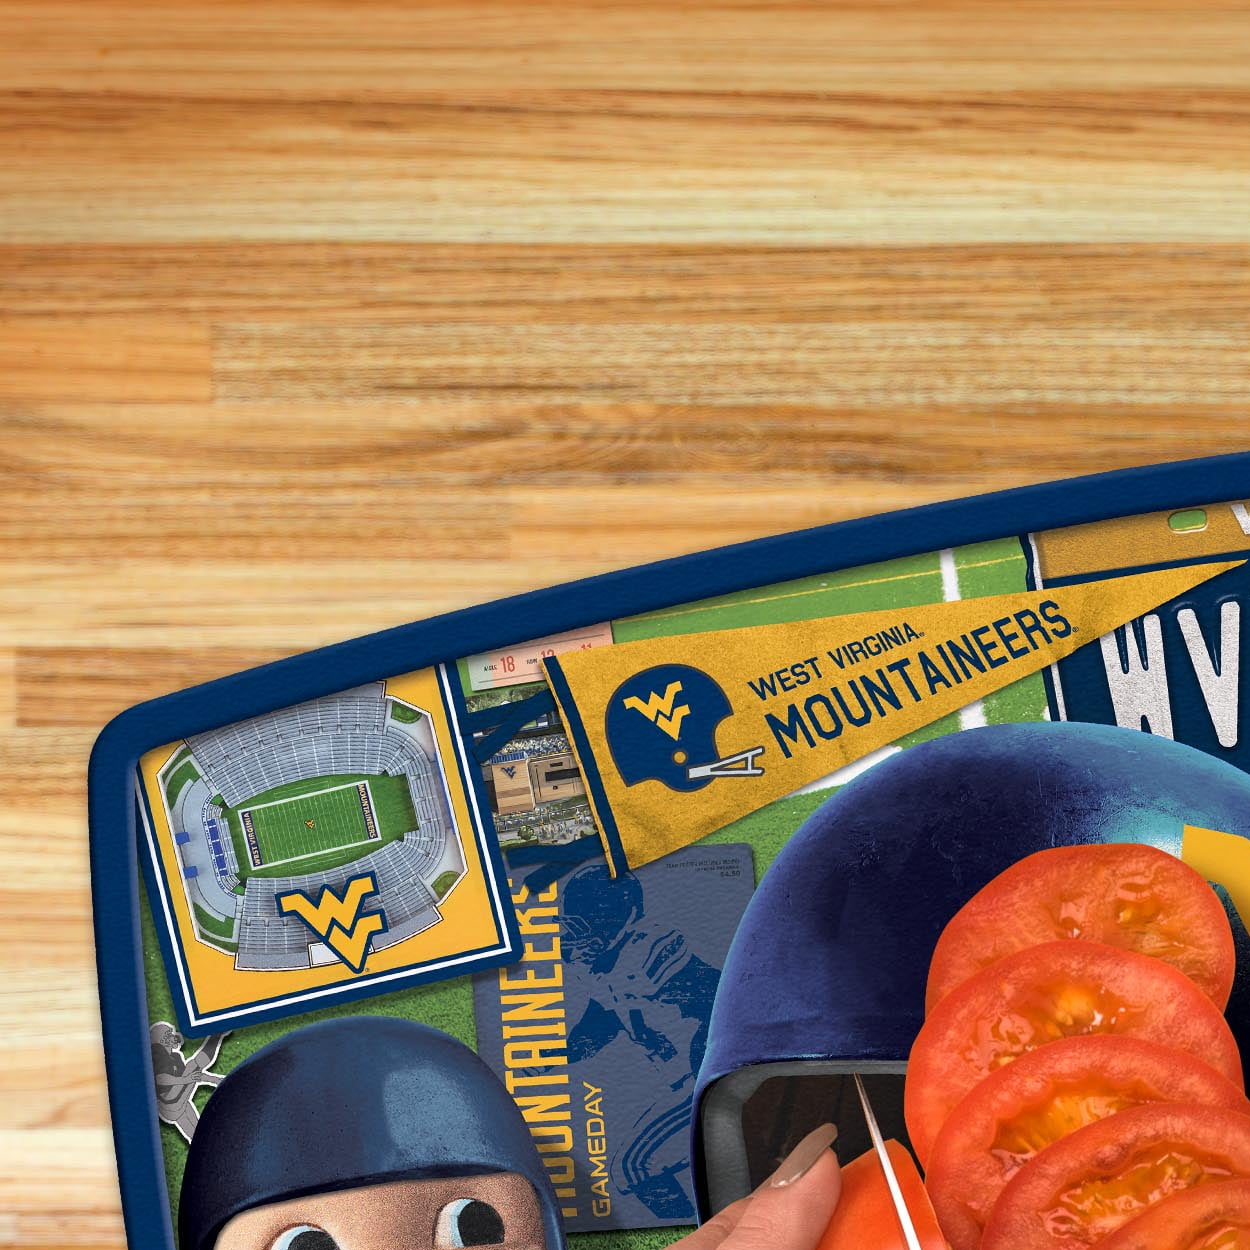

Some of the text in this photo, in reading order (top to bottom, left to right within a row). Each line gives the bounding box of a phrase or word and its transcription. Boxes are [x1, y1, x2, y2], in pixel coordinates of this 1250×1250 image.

[500, 655, 515, 673] 18
[747, 622, 919, 701] WEST VIRGINIA
[764, 600, 1074, 759] MOUNTAINEERS
[499, 878, 577, 1217] UNTAINEER
[582, 1081, 611, 1217] GAMEDAY
